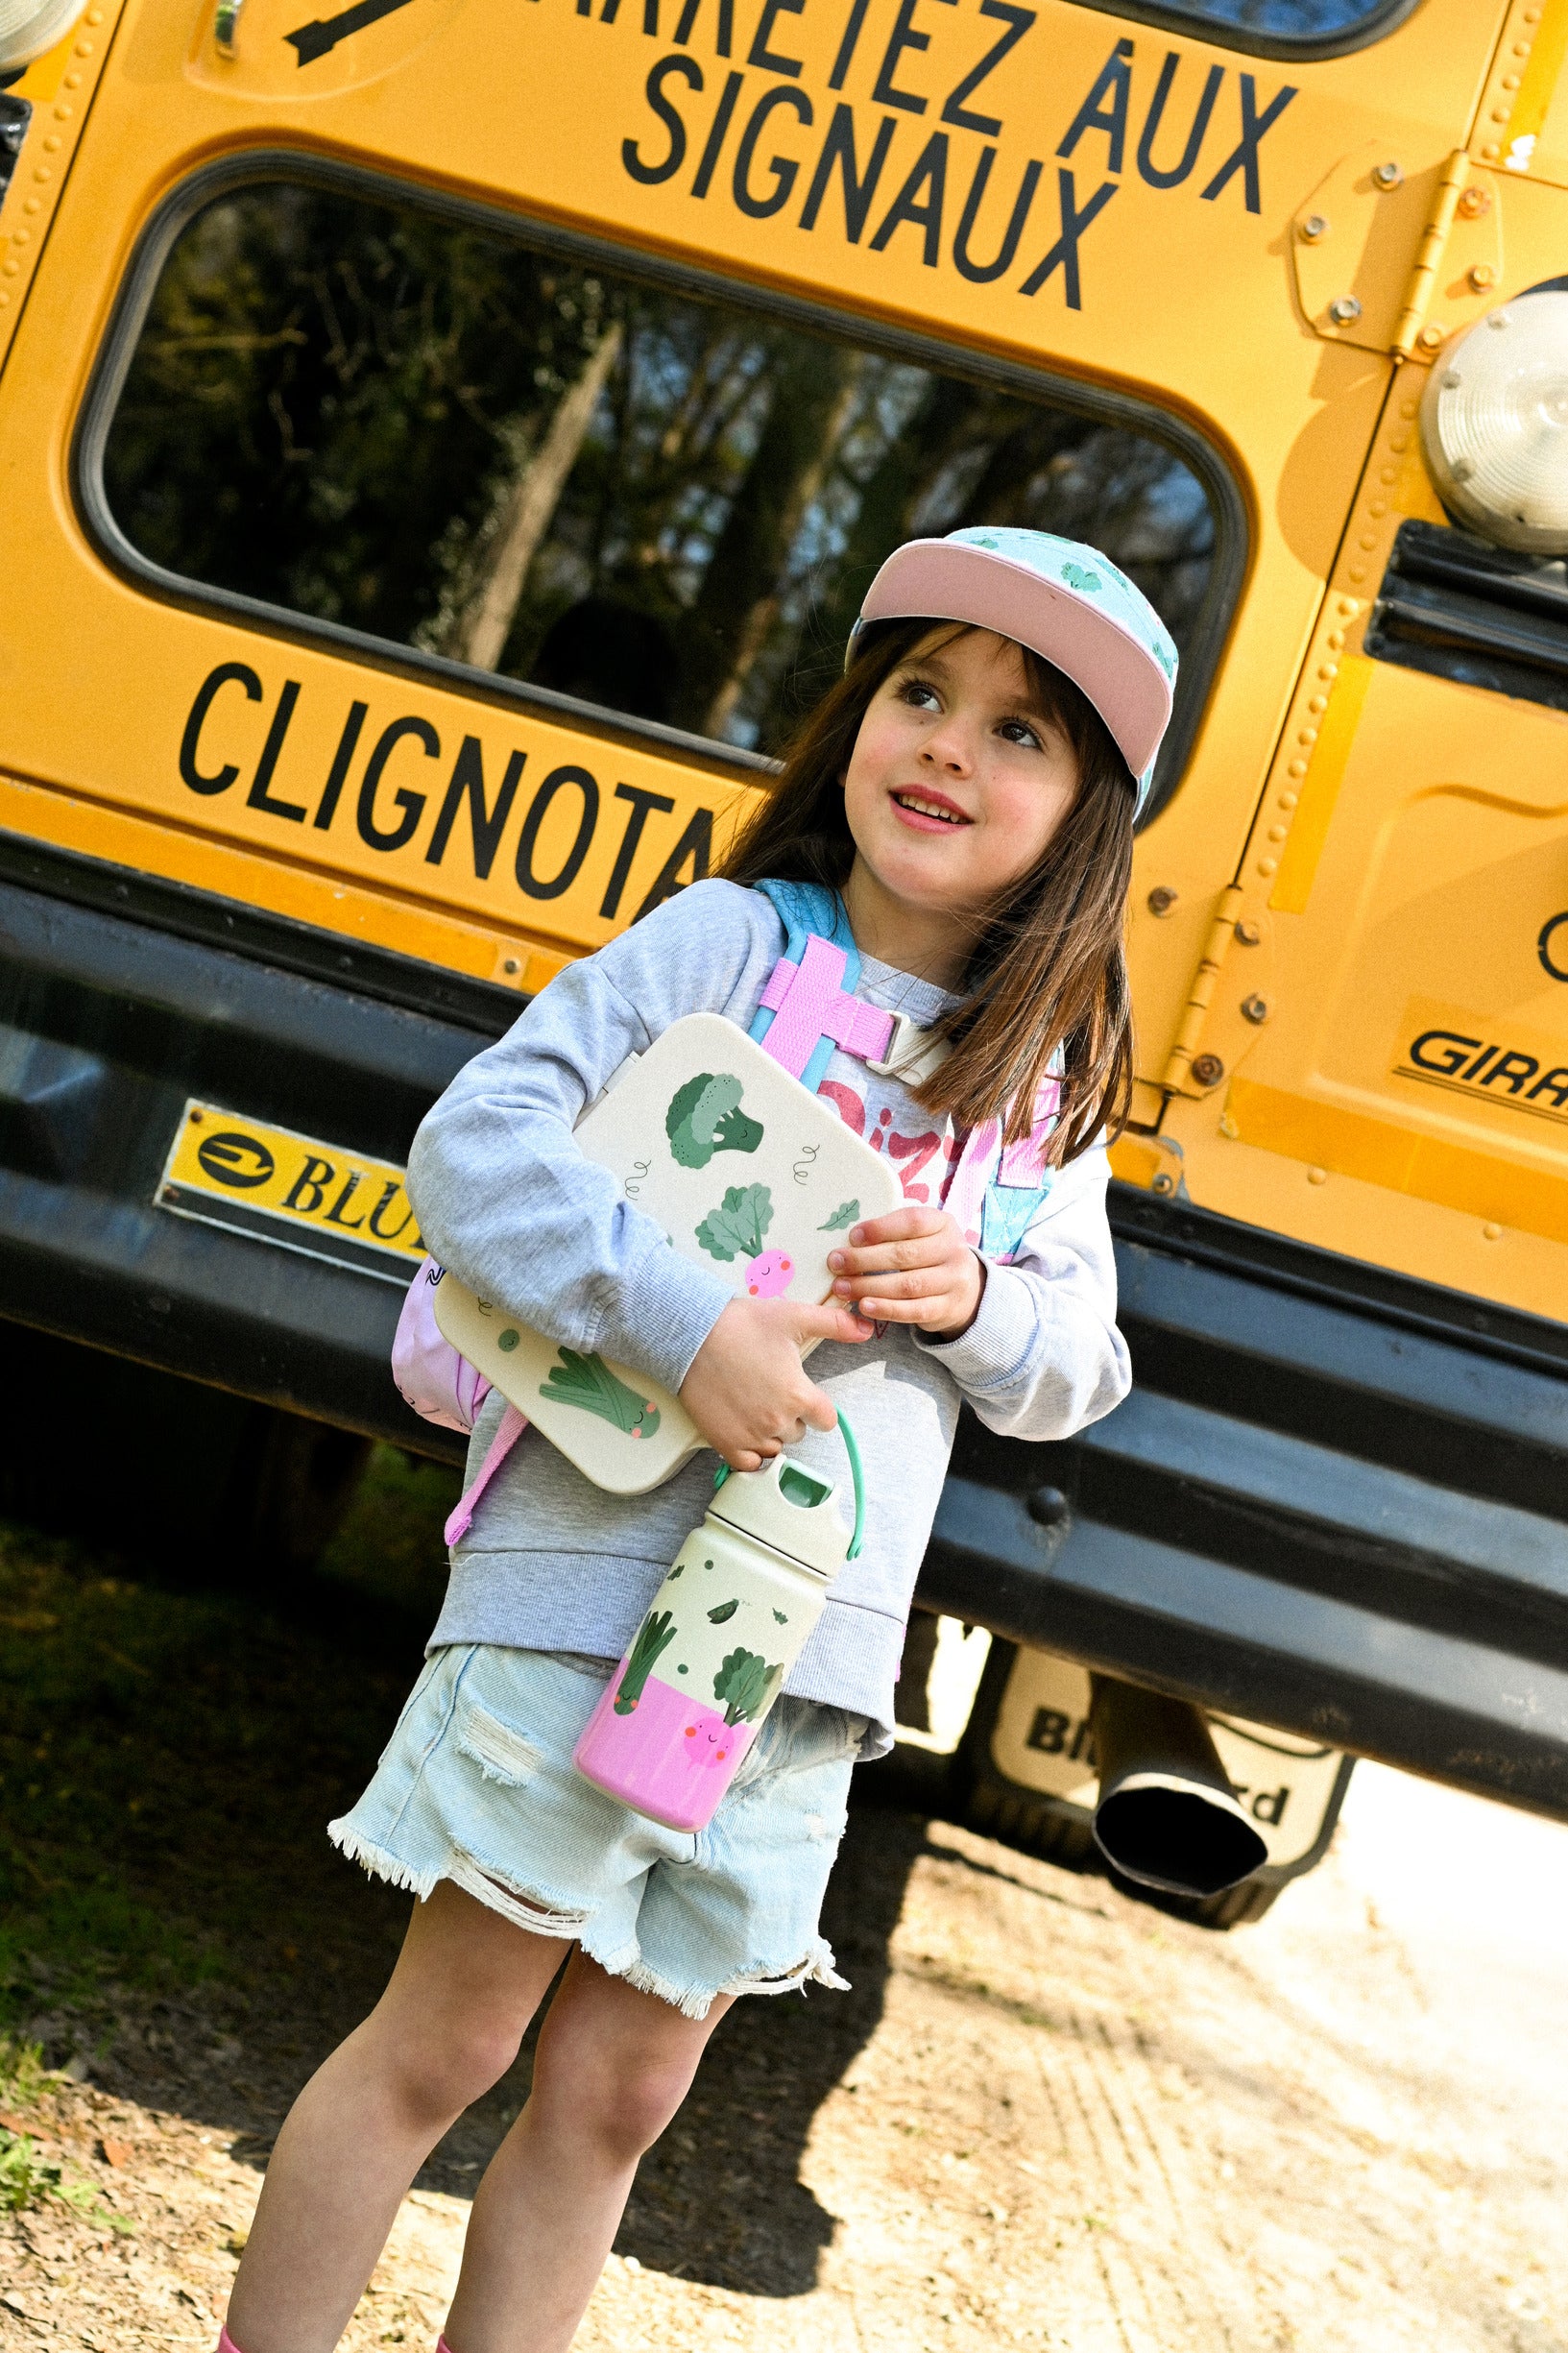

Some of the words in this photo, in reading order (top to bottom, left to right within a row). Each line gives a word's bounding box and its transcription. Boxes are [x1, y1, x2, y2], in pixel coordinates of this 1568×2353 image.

[622, 54, 1119, 311] SIGNAUX
[1055, 37, 1299, 215] AUX
[281, 1155, 429, 1252] BLU
